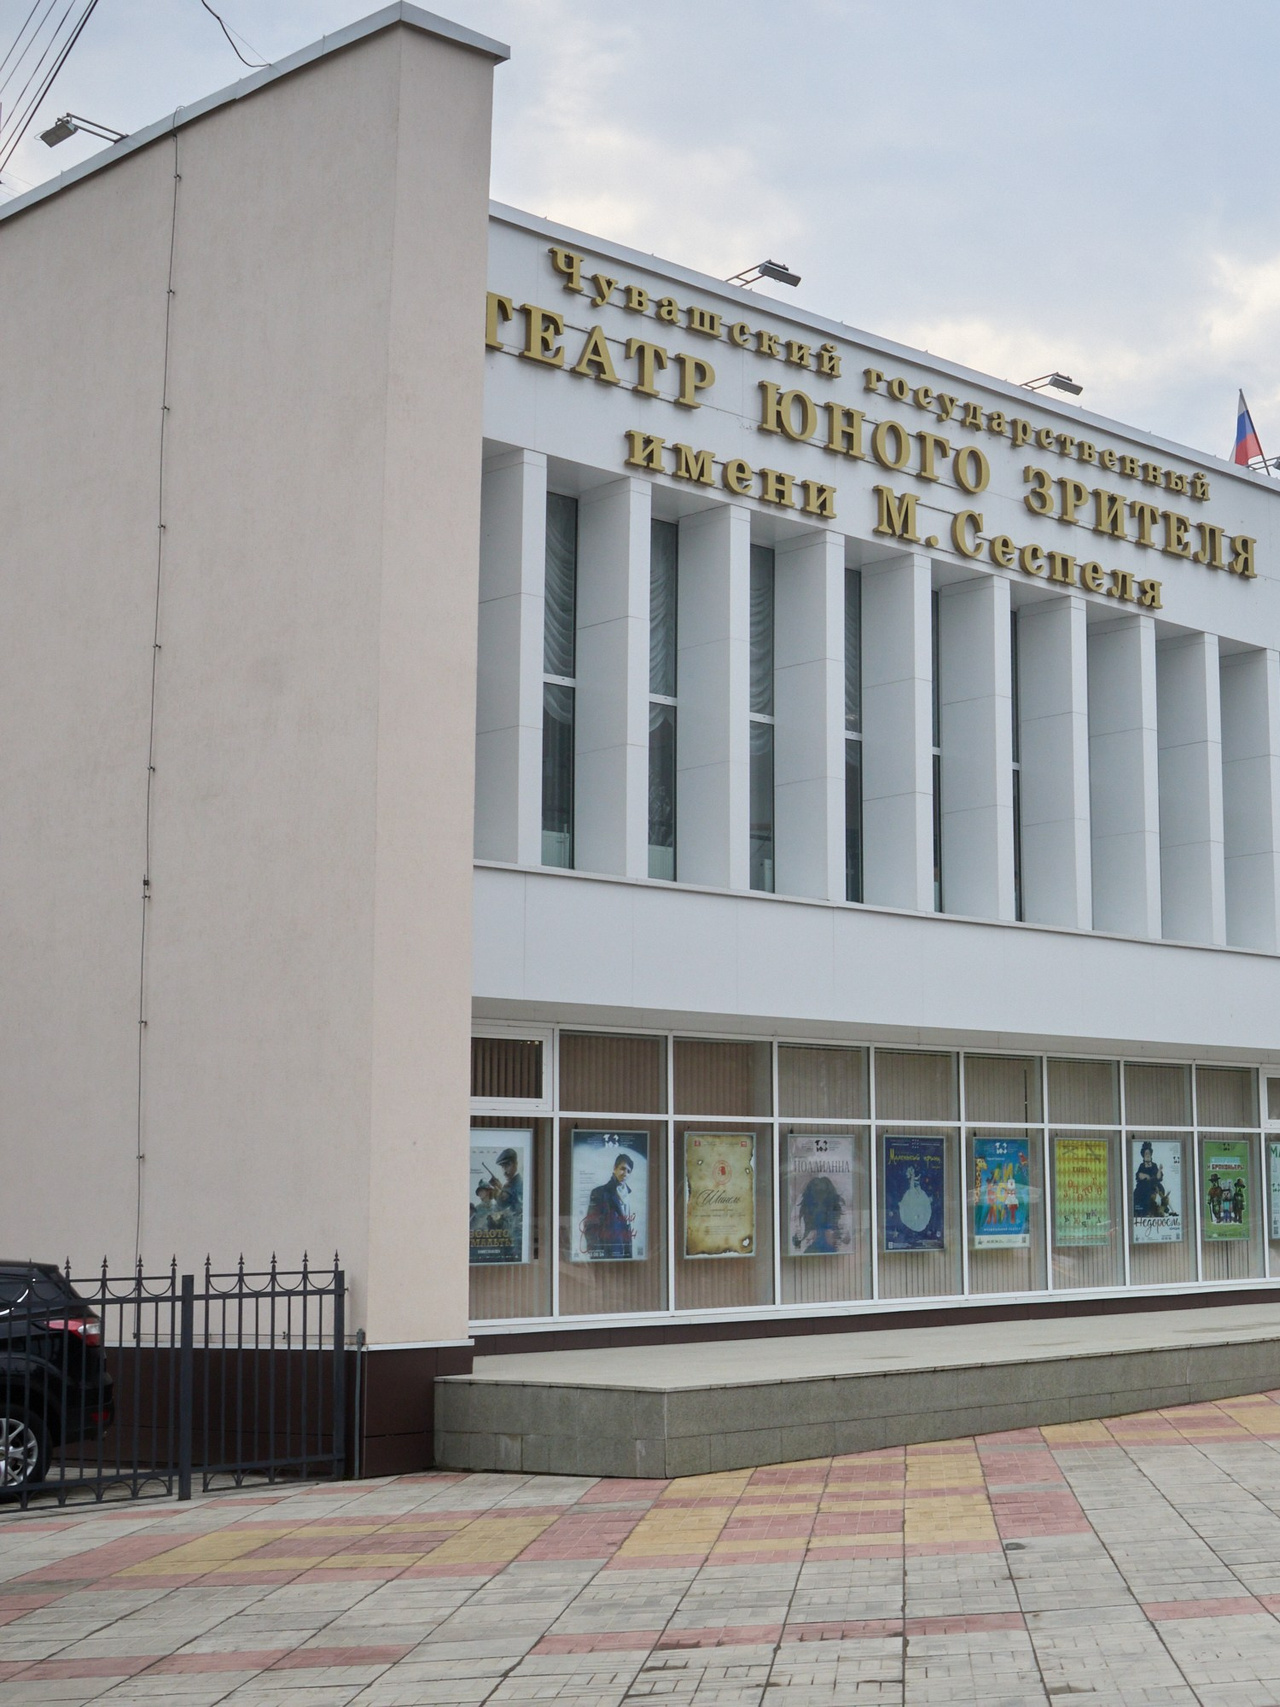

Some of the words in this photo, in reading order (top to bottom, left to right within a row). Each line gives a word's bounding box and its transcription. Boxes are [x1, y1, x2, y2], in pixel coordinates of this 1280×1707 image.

[485, 291, 716, 409] ТЕАТР
[757, 380, 991, 494] ЮНОГО
[1023, 465, 1258, 579] ЗРИТЕЛЯ
[548, 247, 842, 378] Чувашский
[863, 367, 1211, 501] государственный
[625, 430, 837, 519] имени
